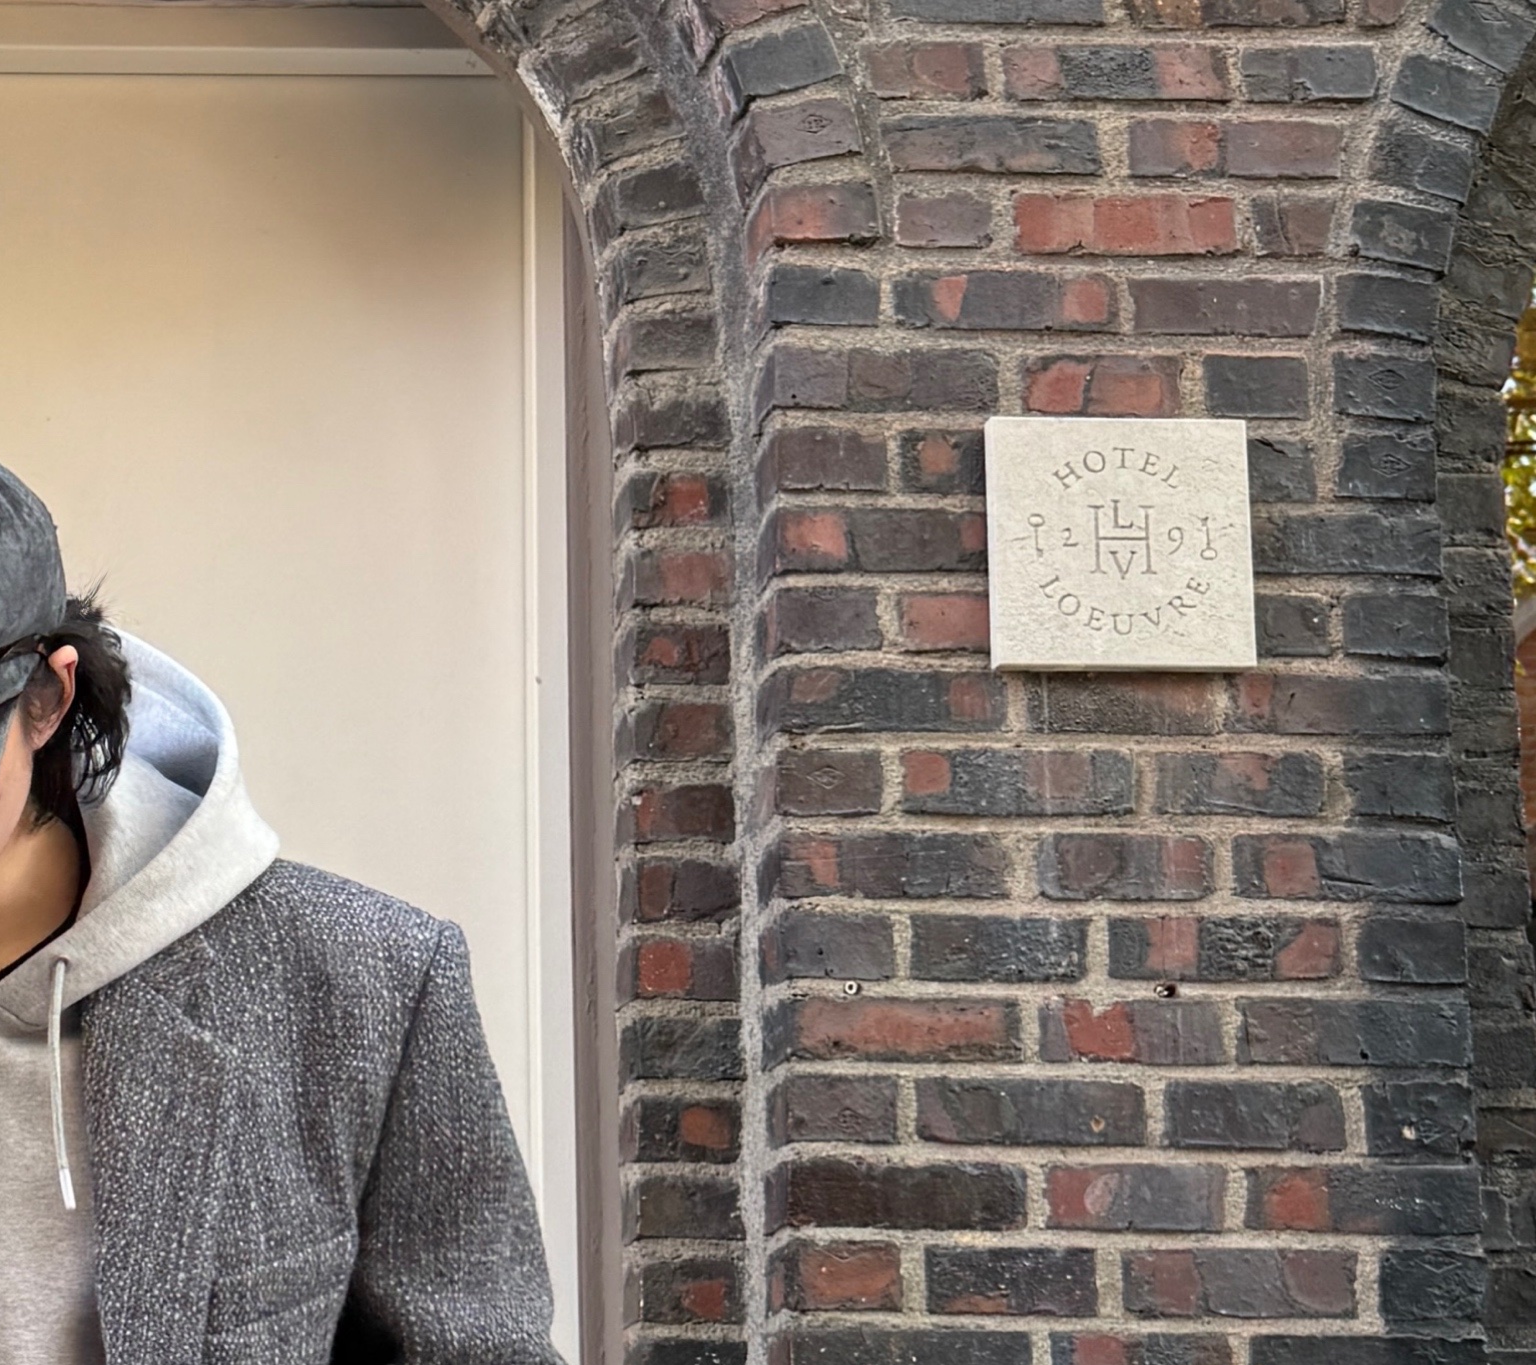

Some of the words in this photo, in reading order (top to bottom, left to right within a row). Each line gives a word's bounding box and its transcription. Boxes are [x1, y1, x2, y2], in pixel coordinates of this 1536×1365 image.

[1053, 447, 1180, 489] HOTEL
[1061, 526, 1080, 548] 2
[1167, 526, 1185, 556] 9
[1039, 575, 1211, 636] LOEUVRE
